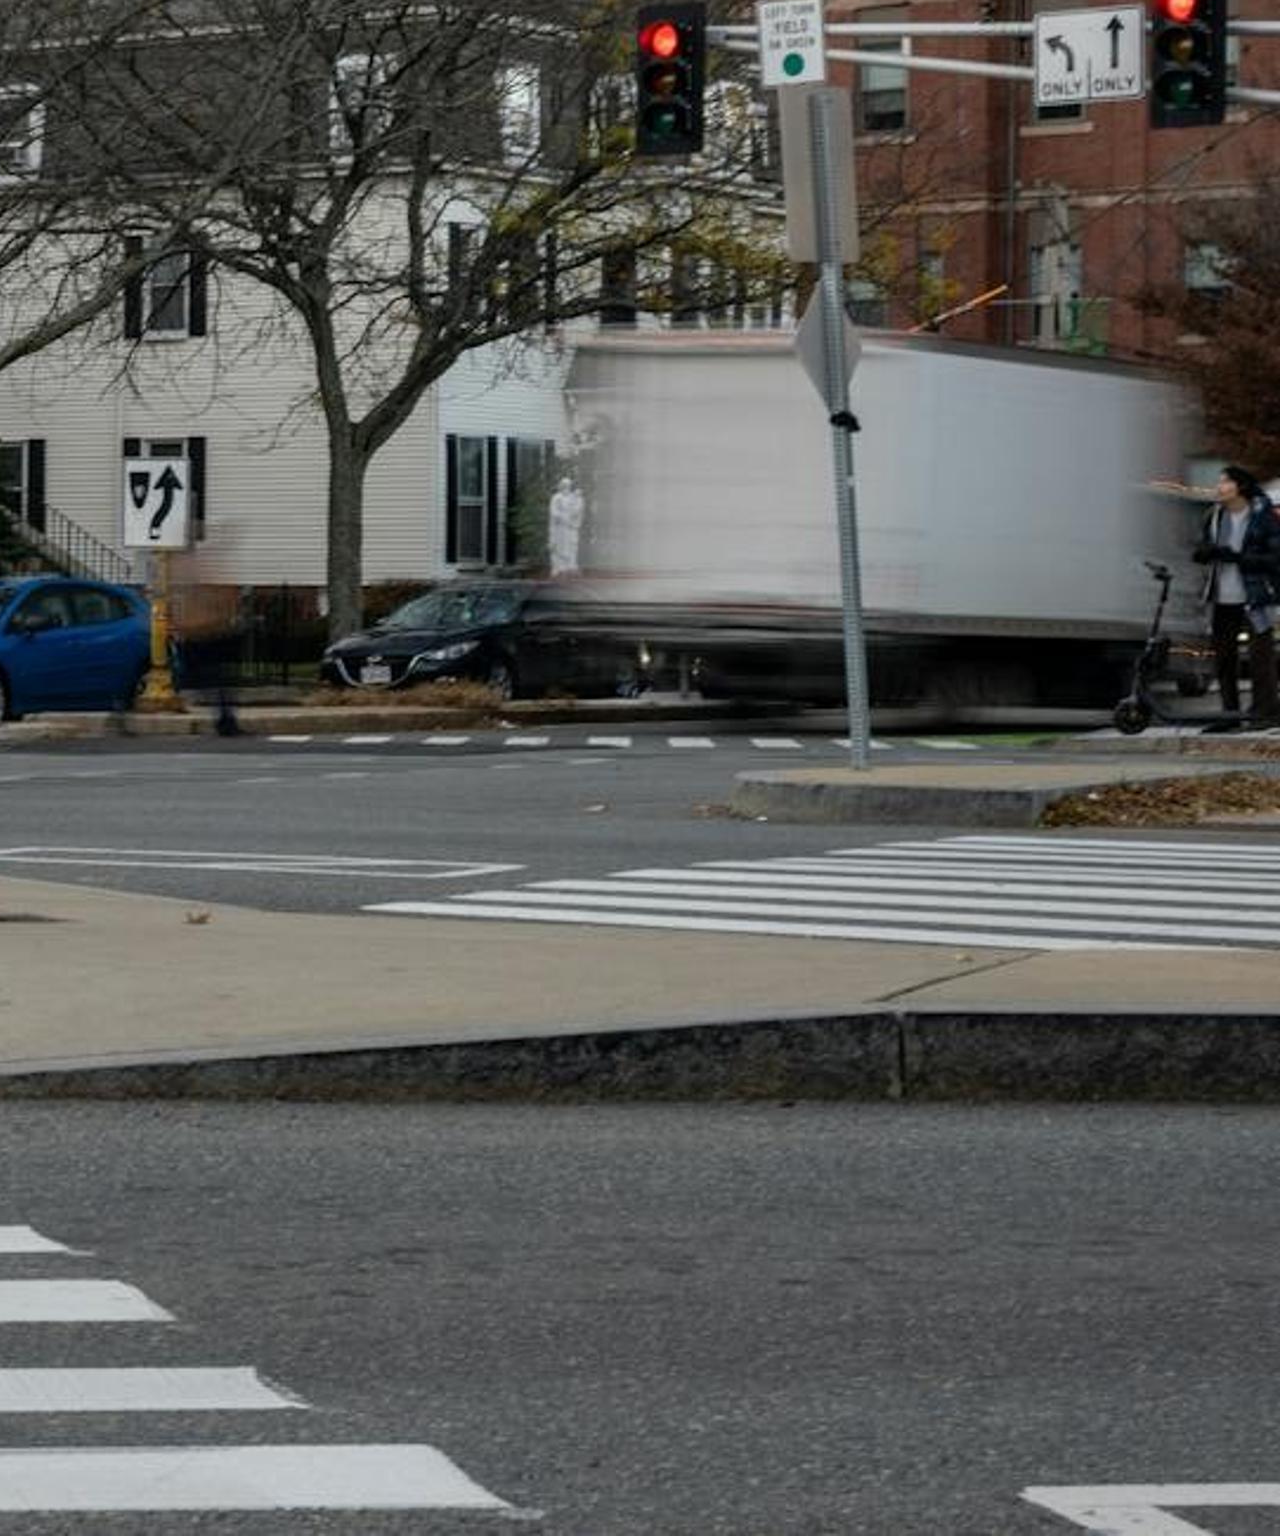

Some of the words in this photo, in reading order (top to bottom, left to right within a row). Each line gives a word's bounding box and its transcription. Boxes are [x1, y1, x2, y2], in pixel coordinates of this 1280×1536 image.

[773, 18, 808, 35] YIELD
[1042, 78, 1081, 97] ONLY
[1094, 74, 1135, 93] ONLY
